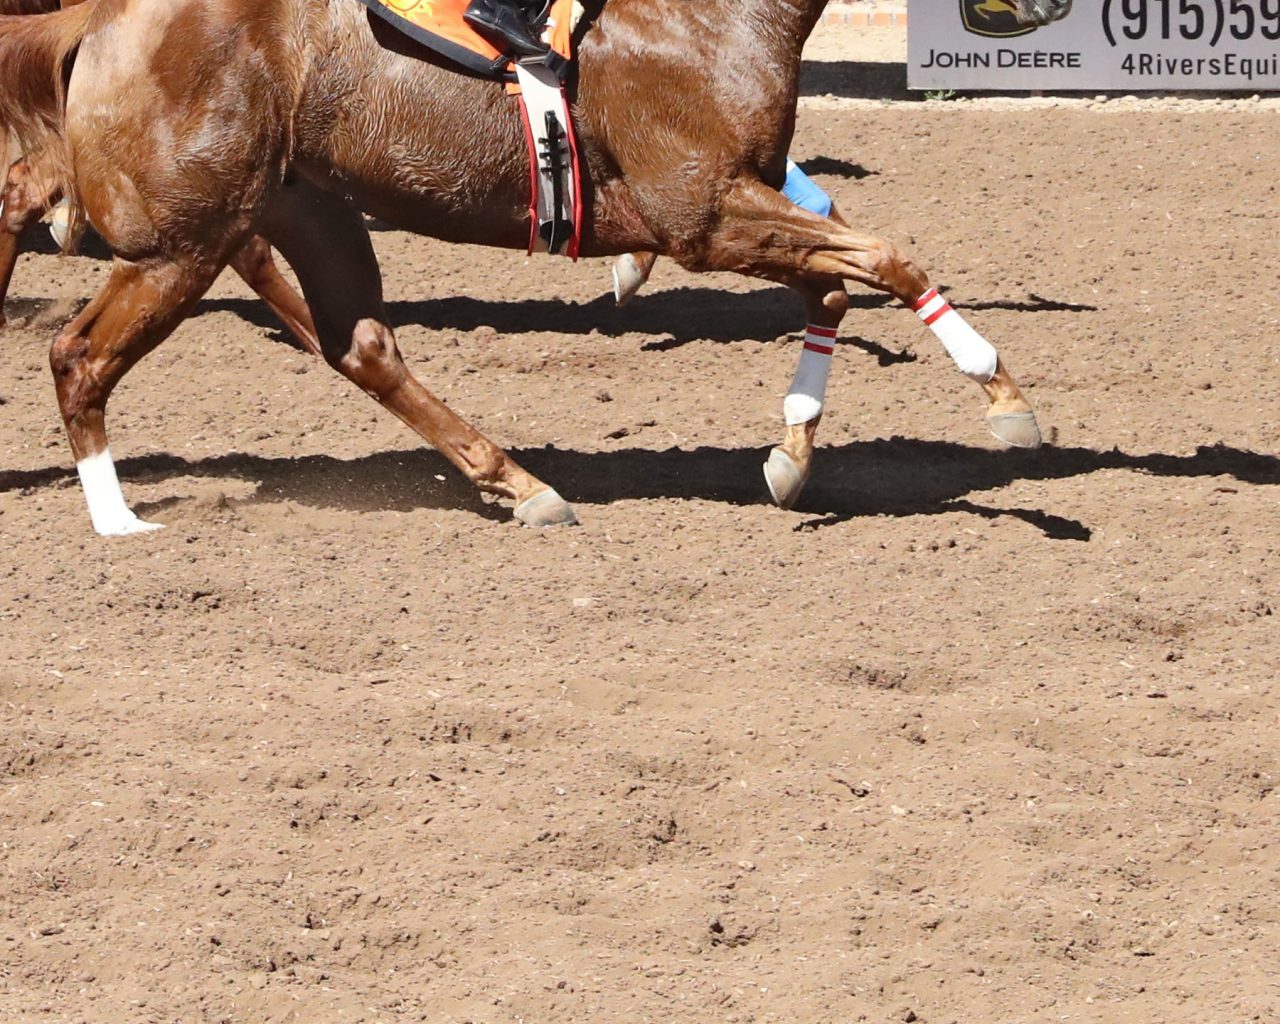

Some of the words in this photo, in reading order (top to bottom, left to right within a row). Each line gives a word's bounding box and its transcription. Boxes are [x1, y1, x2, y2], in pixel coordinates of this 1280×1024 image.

[920, 48, 990, 68] JOHN
[997, 48, 1081, 68] DEERE
[1121, 53, 1277, 81] 4RiversEqui
